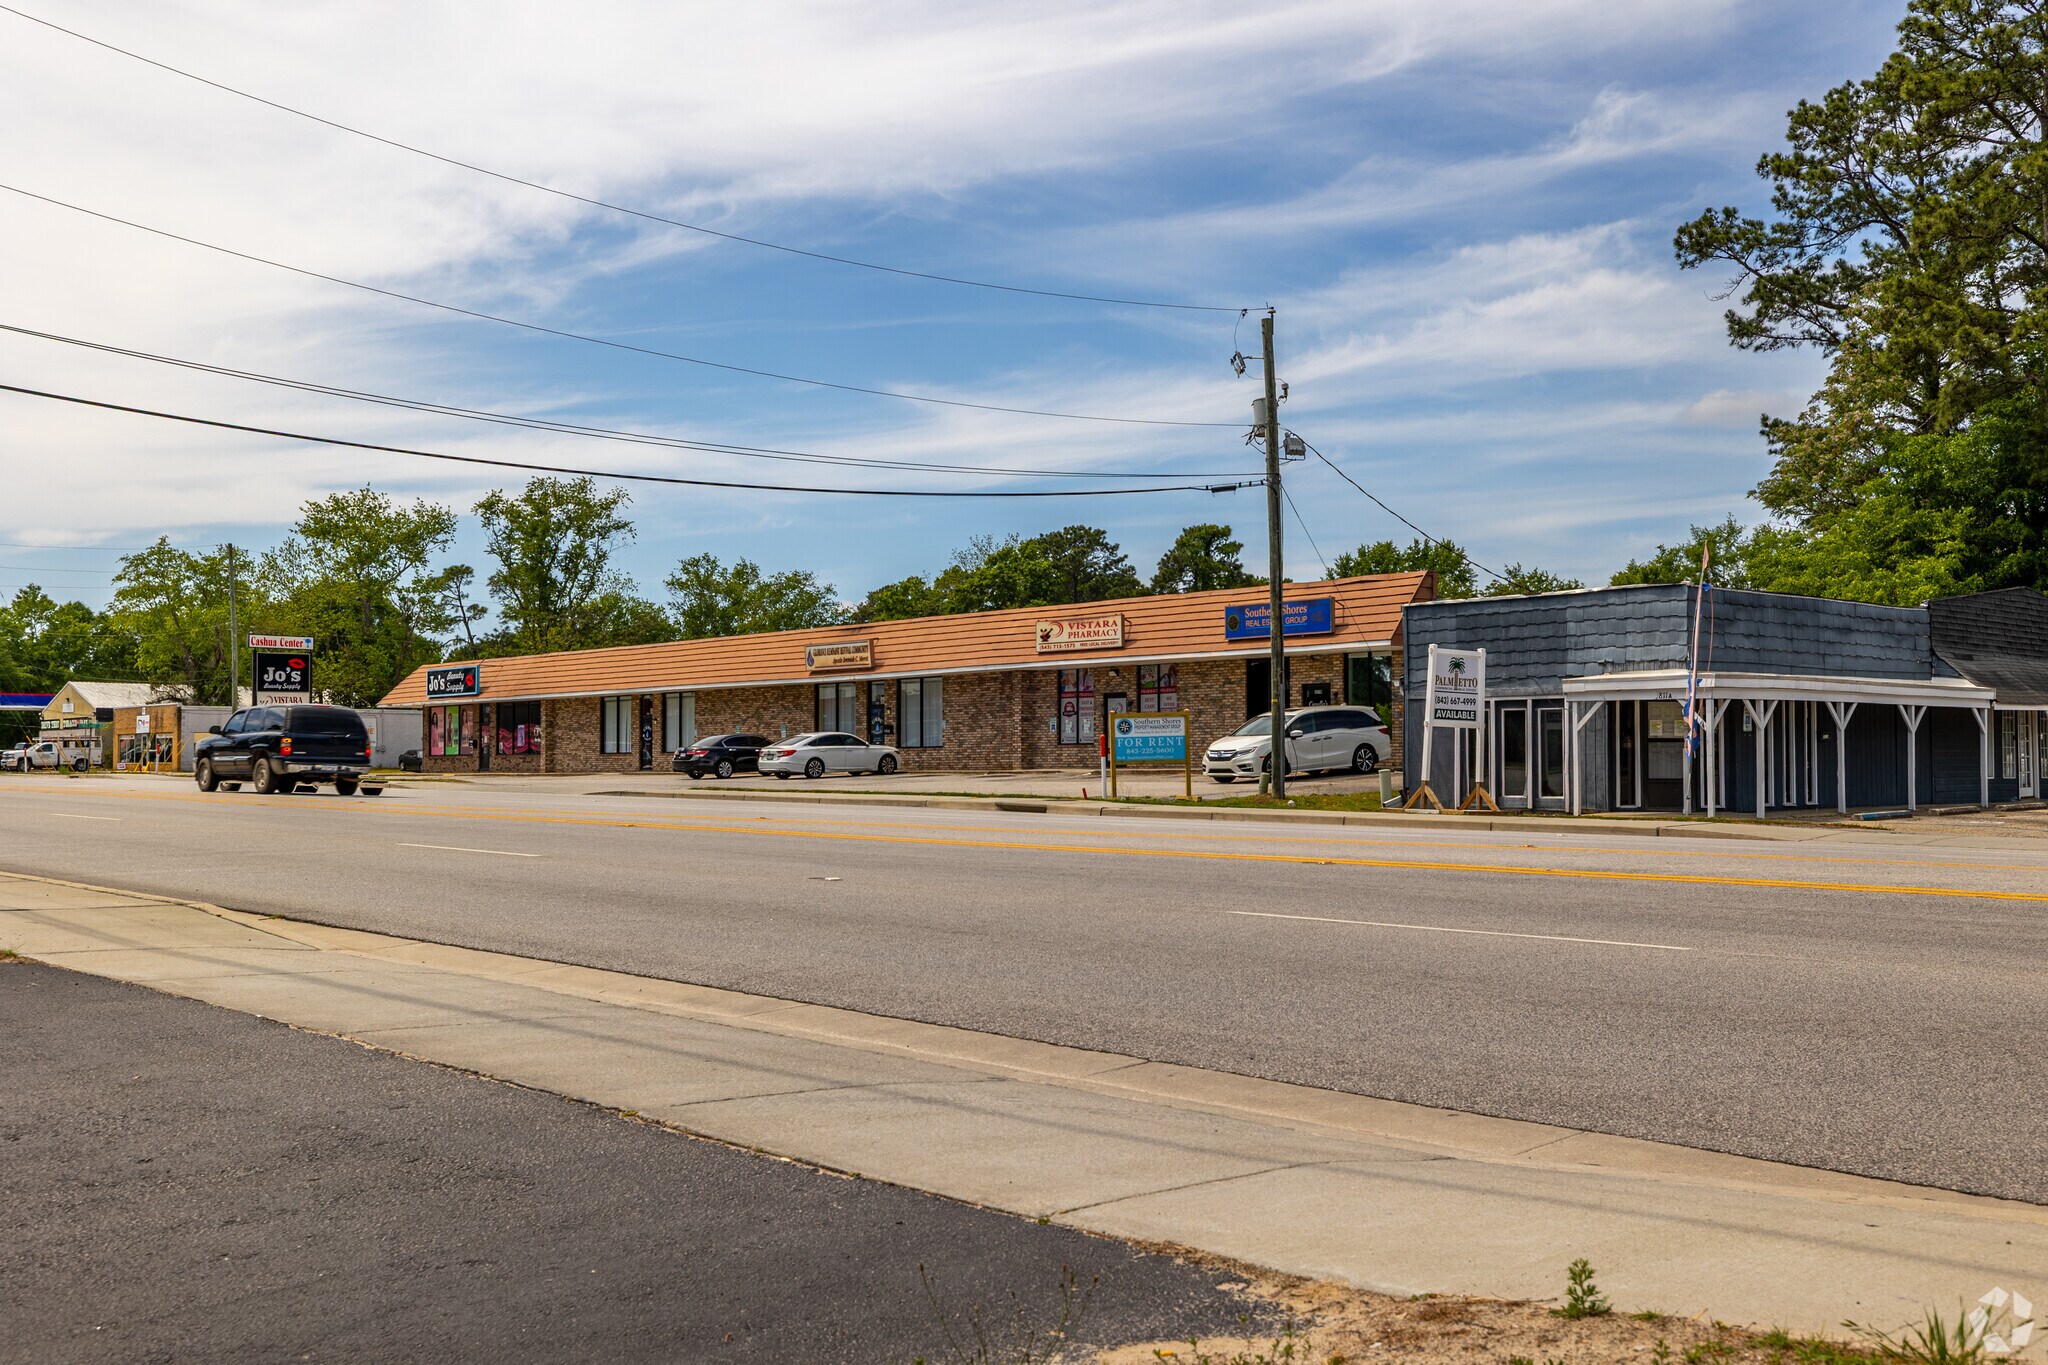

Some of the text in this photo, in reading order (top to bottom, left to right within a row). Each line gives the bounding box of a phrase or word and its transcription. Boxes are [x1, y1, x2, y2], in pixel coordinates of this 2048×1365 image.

[1245, 606, 1271, 618] Southe
[1068, 620, 1118, 630] VISTARA
[1285, 616, 1308, 624] GROUP
[1068, 629, 1119, 639] PHARMACY
[250, 636, 304, 648] Cashua Center
[263, 667, 301, 682] Jo's
[429, 674, 445, 691] Jo's
[1435, 695, 1477, 706] (843) 667-4999
[1435, 709, 1475, 719] AVAILABLE
[1117, 737, 1183, 747] FOR RENT
